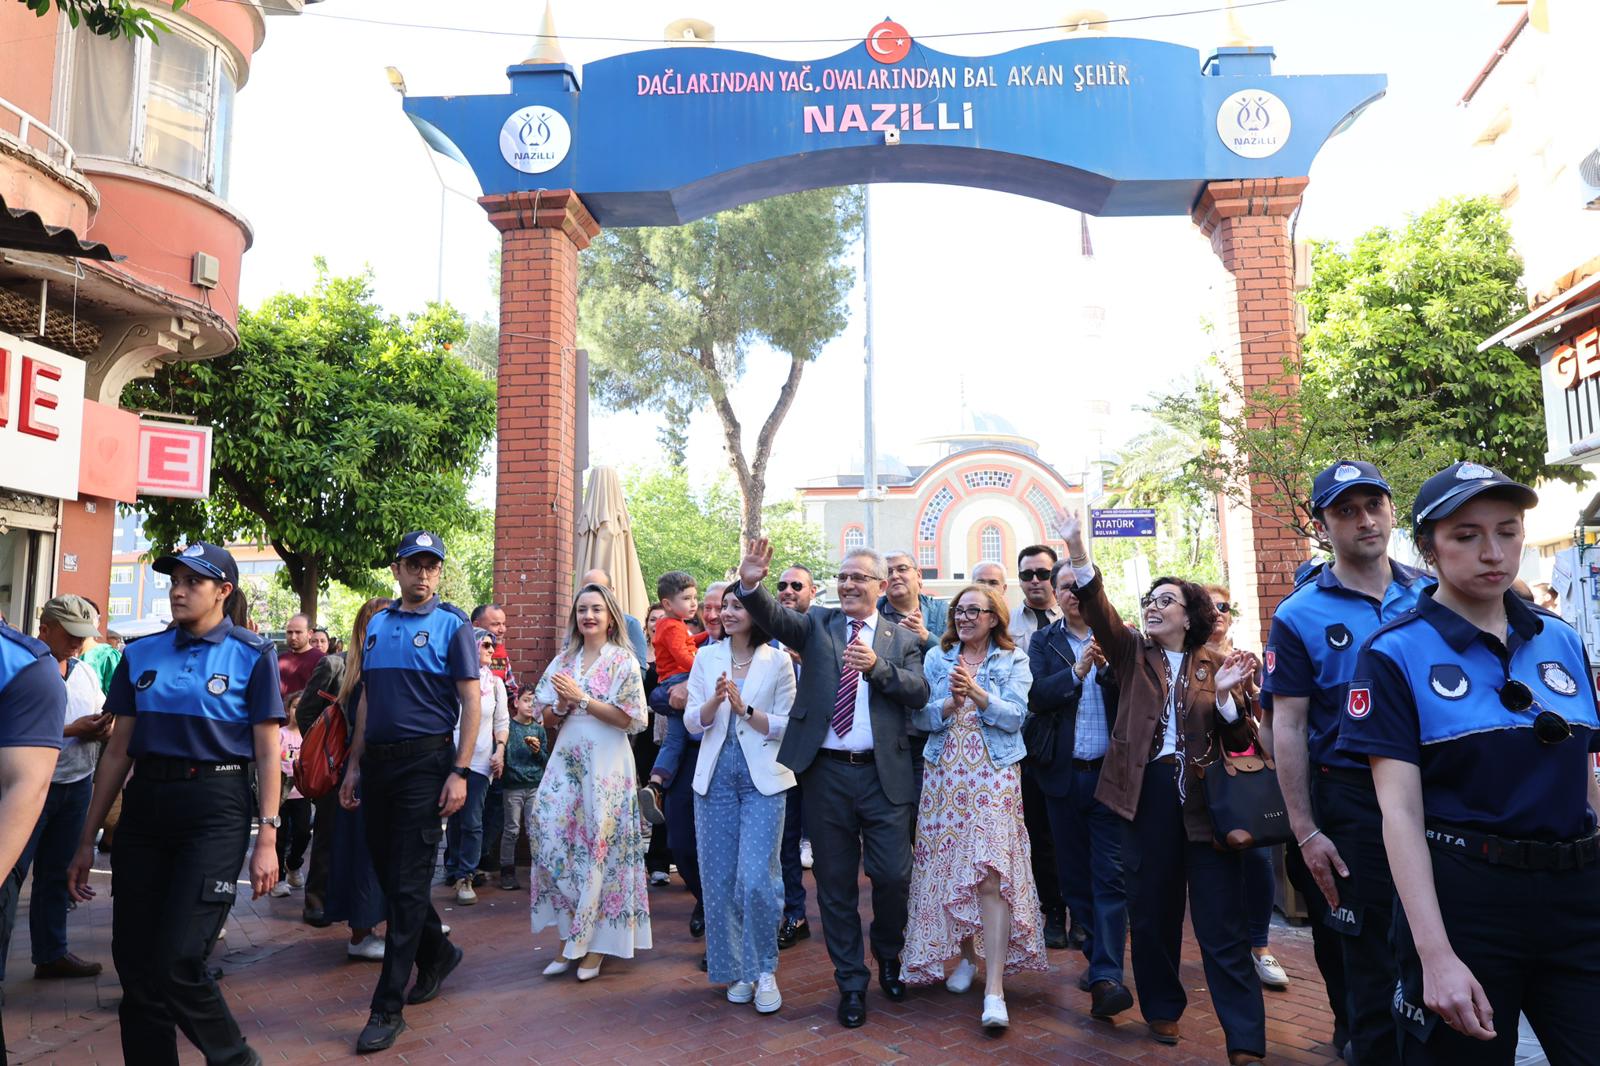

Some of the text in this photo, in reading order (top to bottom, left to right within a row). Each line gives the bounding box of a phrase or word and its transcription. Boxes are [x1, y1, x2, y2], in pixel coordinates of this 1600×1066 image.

[637, 68, 774, 96] DAĞLARINDAN
[963, 66, 998, 88] BAL
[1007, 64, 1064, 87] AKAN
[1073, 61, 1130, 92] ŞEHİR
[147, 436, 190, 482] E
[1095, 518, 1135, 529] ATATÜRK
